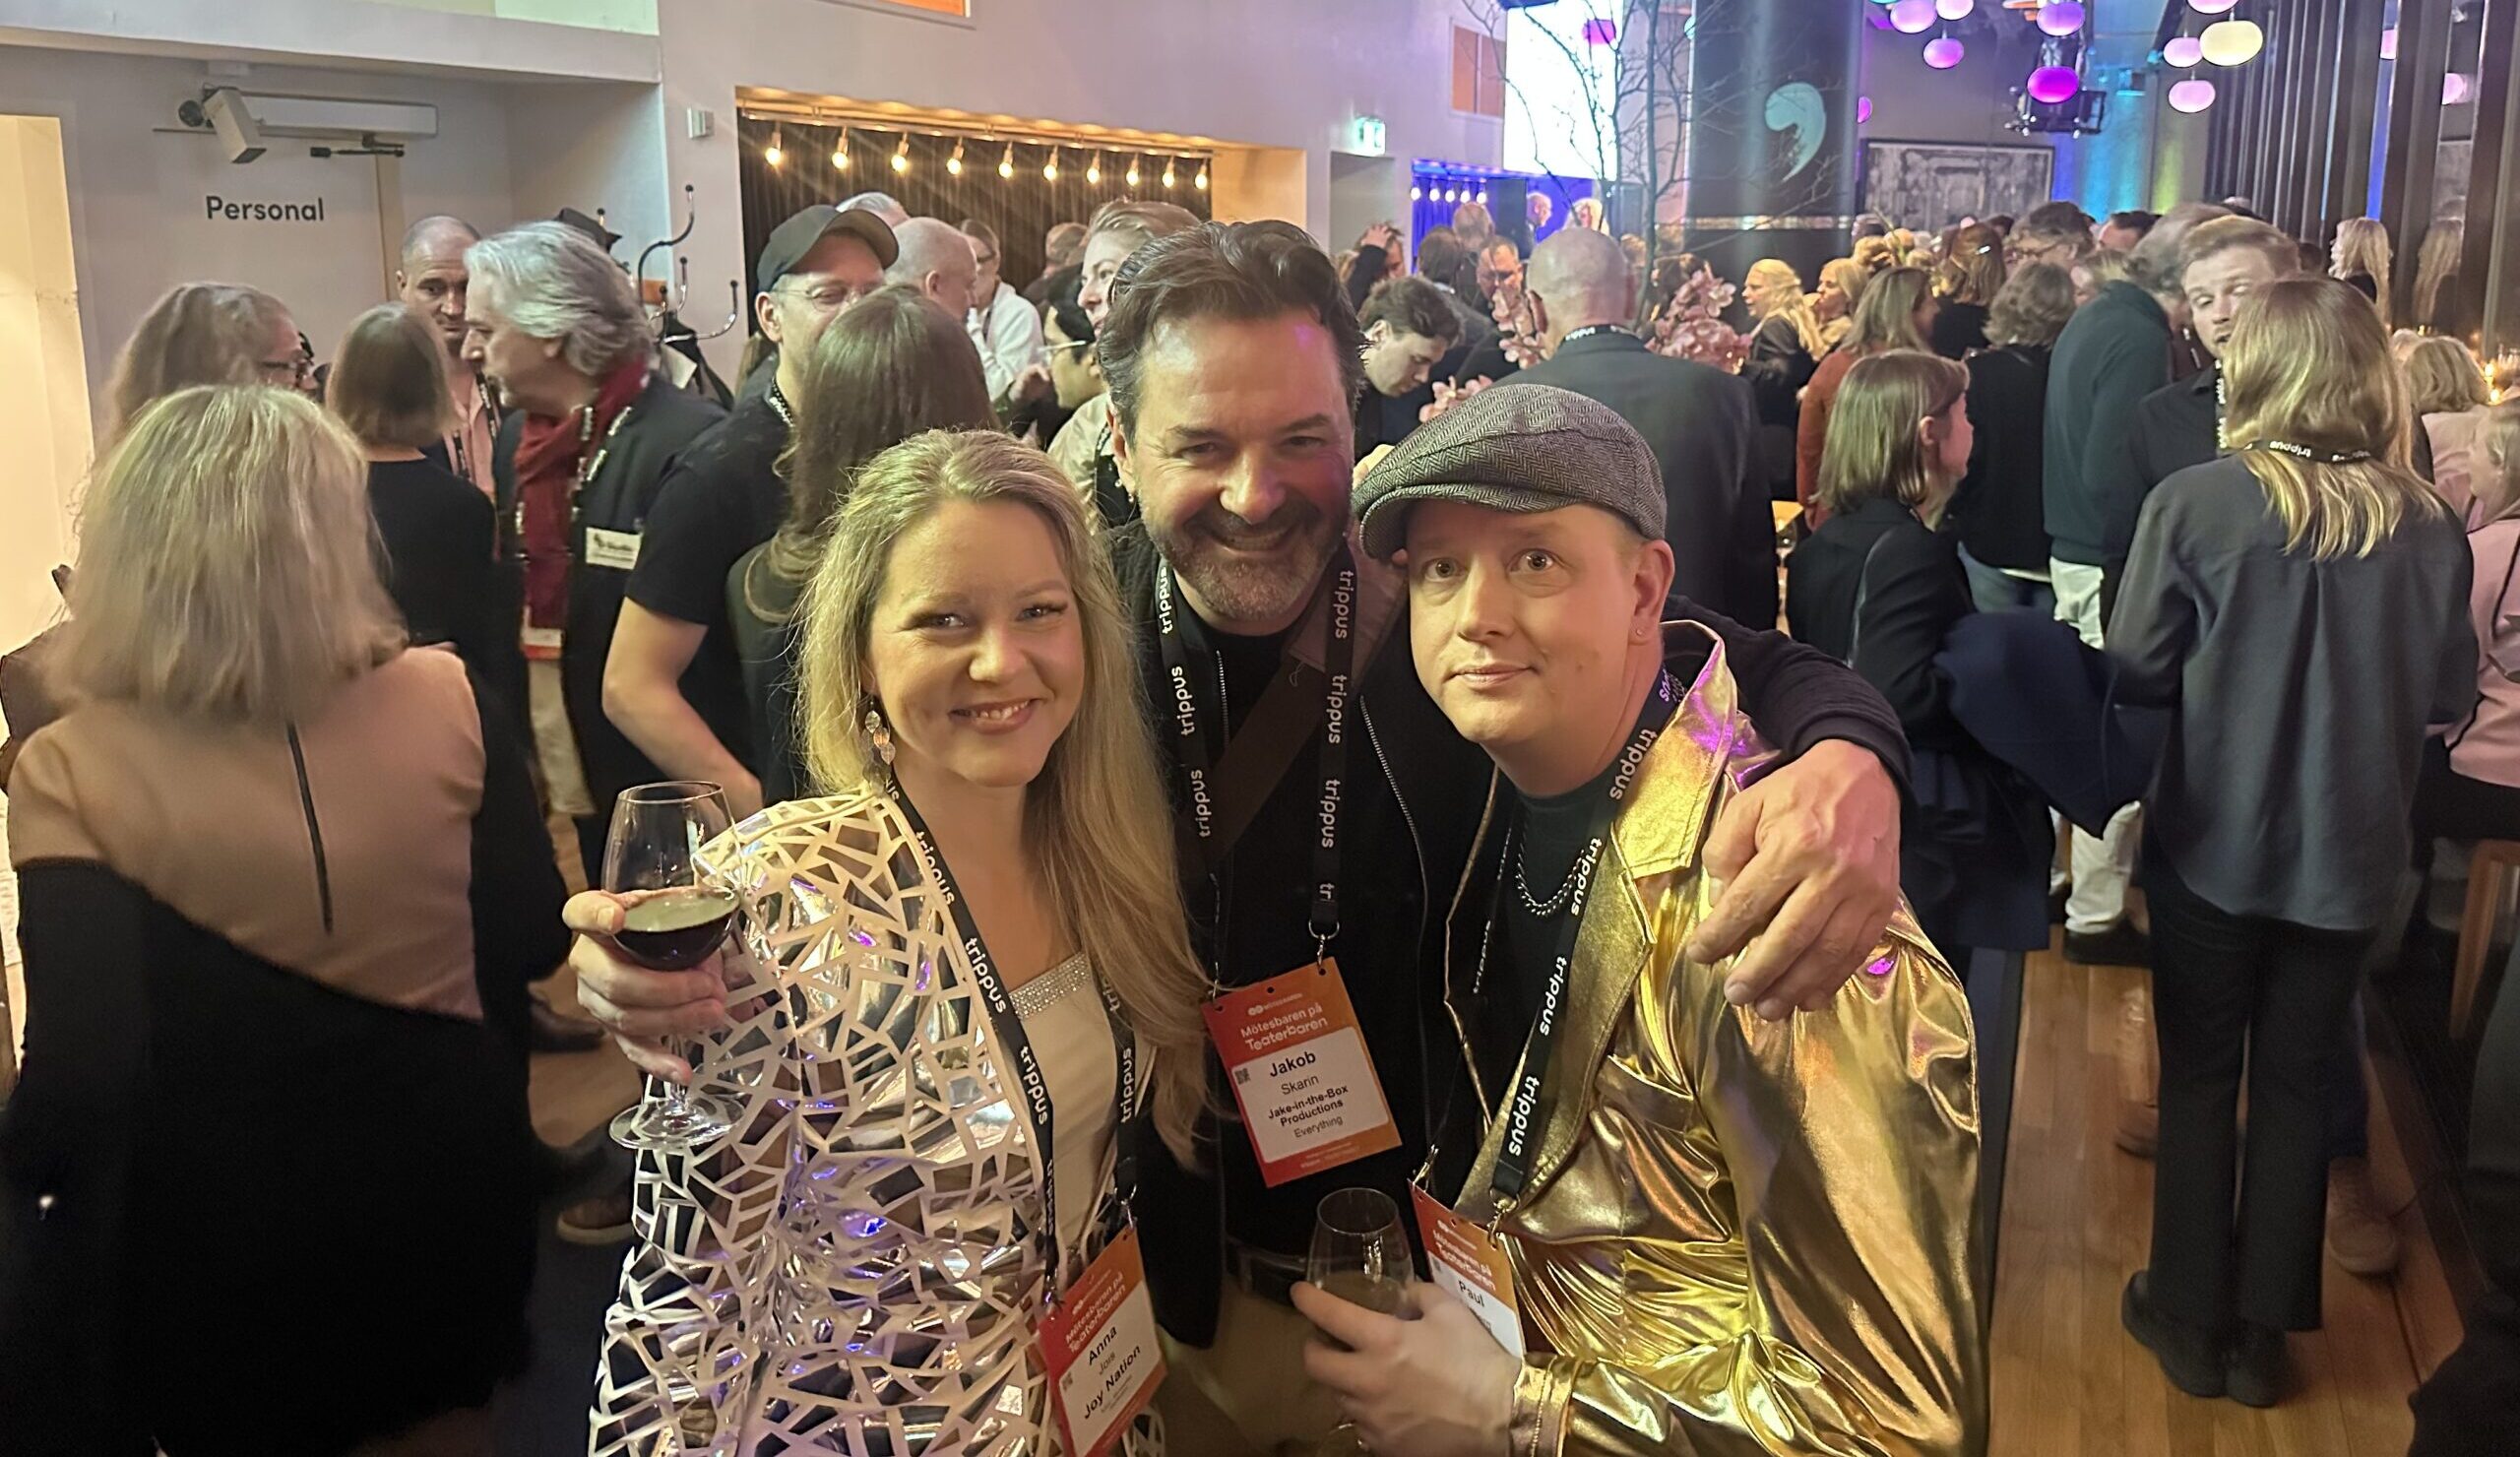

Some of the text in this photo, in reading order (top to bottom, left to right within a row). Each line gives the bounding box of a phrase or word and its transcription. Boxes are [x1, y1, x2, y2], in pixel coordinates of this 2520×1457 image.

[206, 195, 324, 221] Personal
[1157, 566, 1173, 635] trippus
[1335, 569, 1354, 639] trippus
[1171, 665, 1196, 736] trippus
[1326, 674, 1347, 744] trippus
[1608, 728, 1658, 800] trippus
[1190, 769, 1213, 838] trippus
[1319, 779, 1341, 849] trippus
[1570, 837, 1603, 917] trippus
[965, 936, 1008, 1015] trippus
[1540, 955, 1567, 1037] trippus
[1240, 1008, 1307, 1039] Mötesbaren
[1307, 1001, 1323, 1018] på
[1245, 1017, 1329, 1051] Teaterbaren
[1020, 1045, 1048, 1126] trippus
[1120, 1046, 1132, 1123] trippus
[1269, 1050, 1316, 1078] Jakob
[1280, 1074, 1319, 1096] Skarin
[1267, 1084, 1349, 1119] Jake-in-the-Box
[1280, 1099, 1344, 1127] Productions
[1293, 1114, 1344, 1139] Everything
[1508, 1074, 1541, 1158] trippus
[1458, 1280, 1484, 1308] Paul
[1089, 1326, 1117, 1366] Anna
[1085, 1389, 1103, 1420] Joy
[1105, 1345, 1141, 1392] Nation
